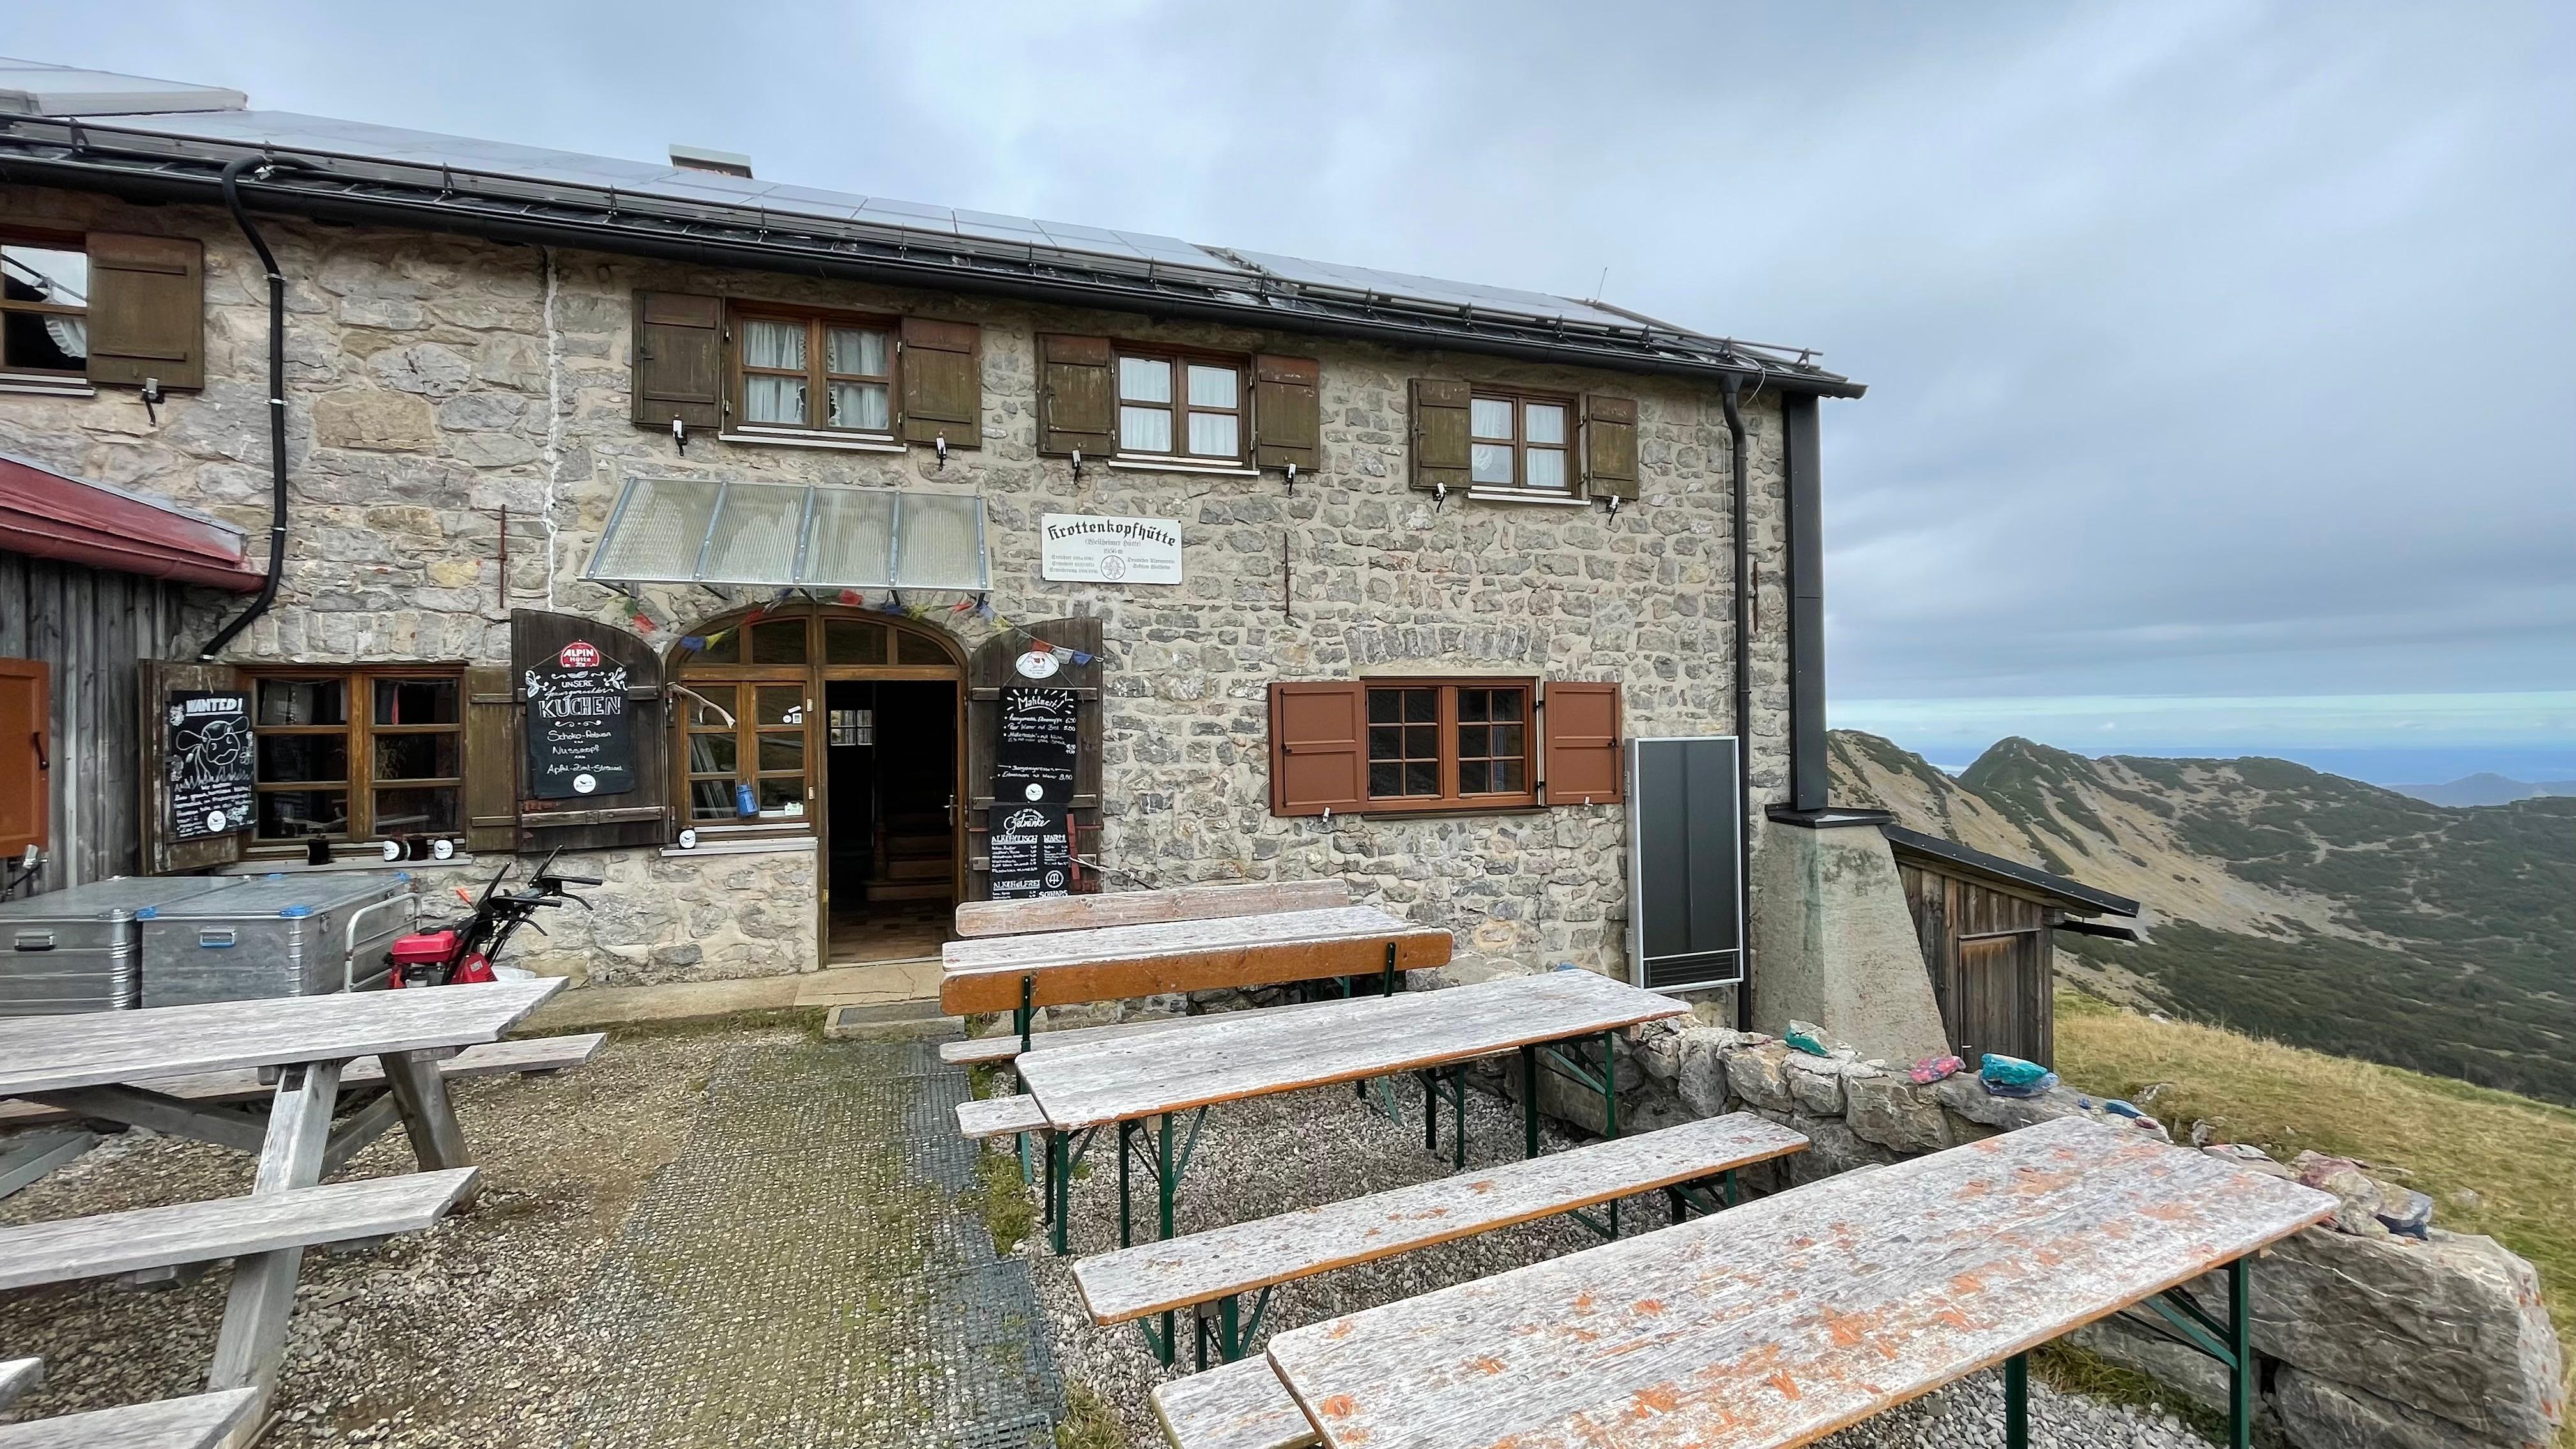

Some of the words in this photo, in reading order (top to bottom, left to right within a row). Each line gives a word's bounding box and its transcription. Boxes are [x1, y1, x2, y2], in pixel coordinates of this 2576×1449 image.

[1048, 518, 1176, 546] Krottenkopfhütte
[564, 648, 594, 657] ALPIN
[562, 680, 594, 688] UNSERE
[186, 698, 243, 712] WANTED!
[539, 696, 621, 718] KUCHEN
[1003, 813, 1050, 834] Getränke
[992, 834, 1038, 843] ALKOHOLISCH
[993, 880, 1040, 889] ALKOHOLFREI
[1039, 890, 1068, 898] SCHNAPS
